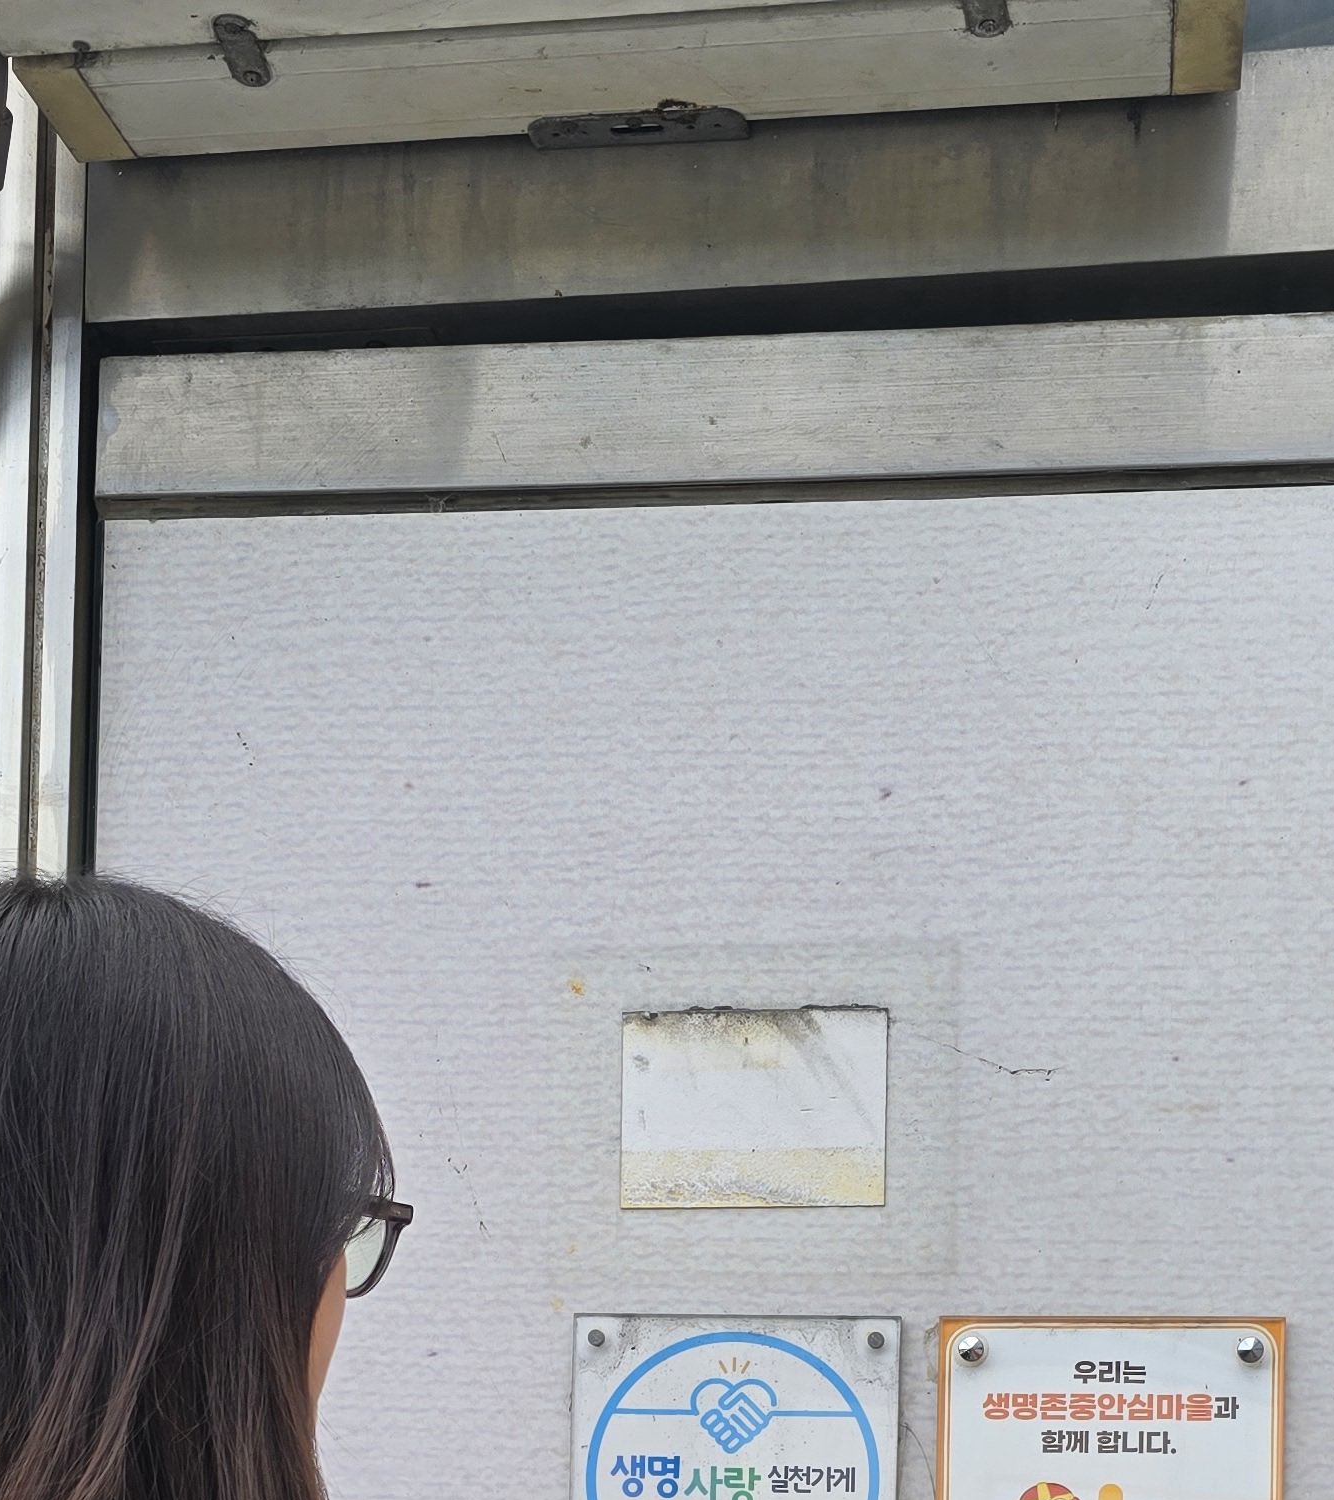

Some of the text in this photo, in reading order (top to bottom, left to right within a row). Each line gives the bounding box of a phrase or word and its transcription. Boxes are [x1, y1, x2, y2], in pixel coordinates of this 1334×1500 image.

[1073, 1360, 1147, 1384] 우리는
[982, 1392, 1240, 1422] 생명존중안심마을과
[1040, 1429, 1177, 1455] 함께 합니다.
[767, 1465, 856, 1494] 실천가게
